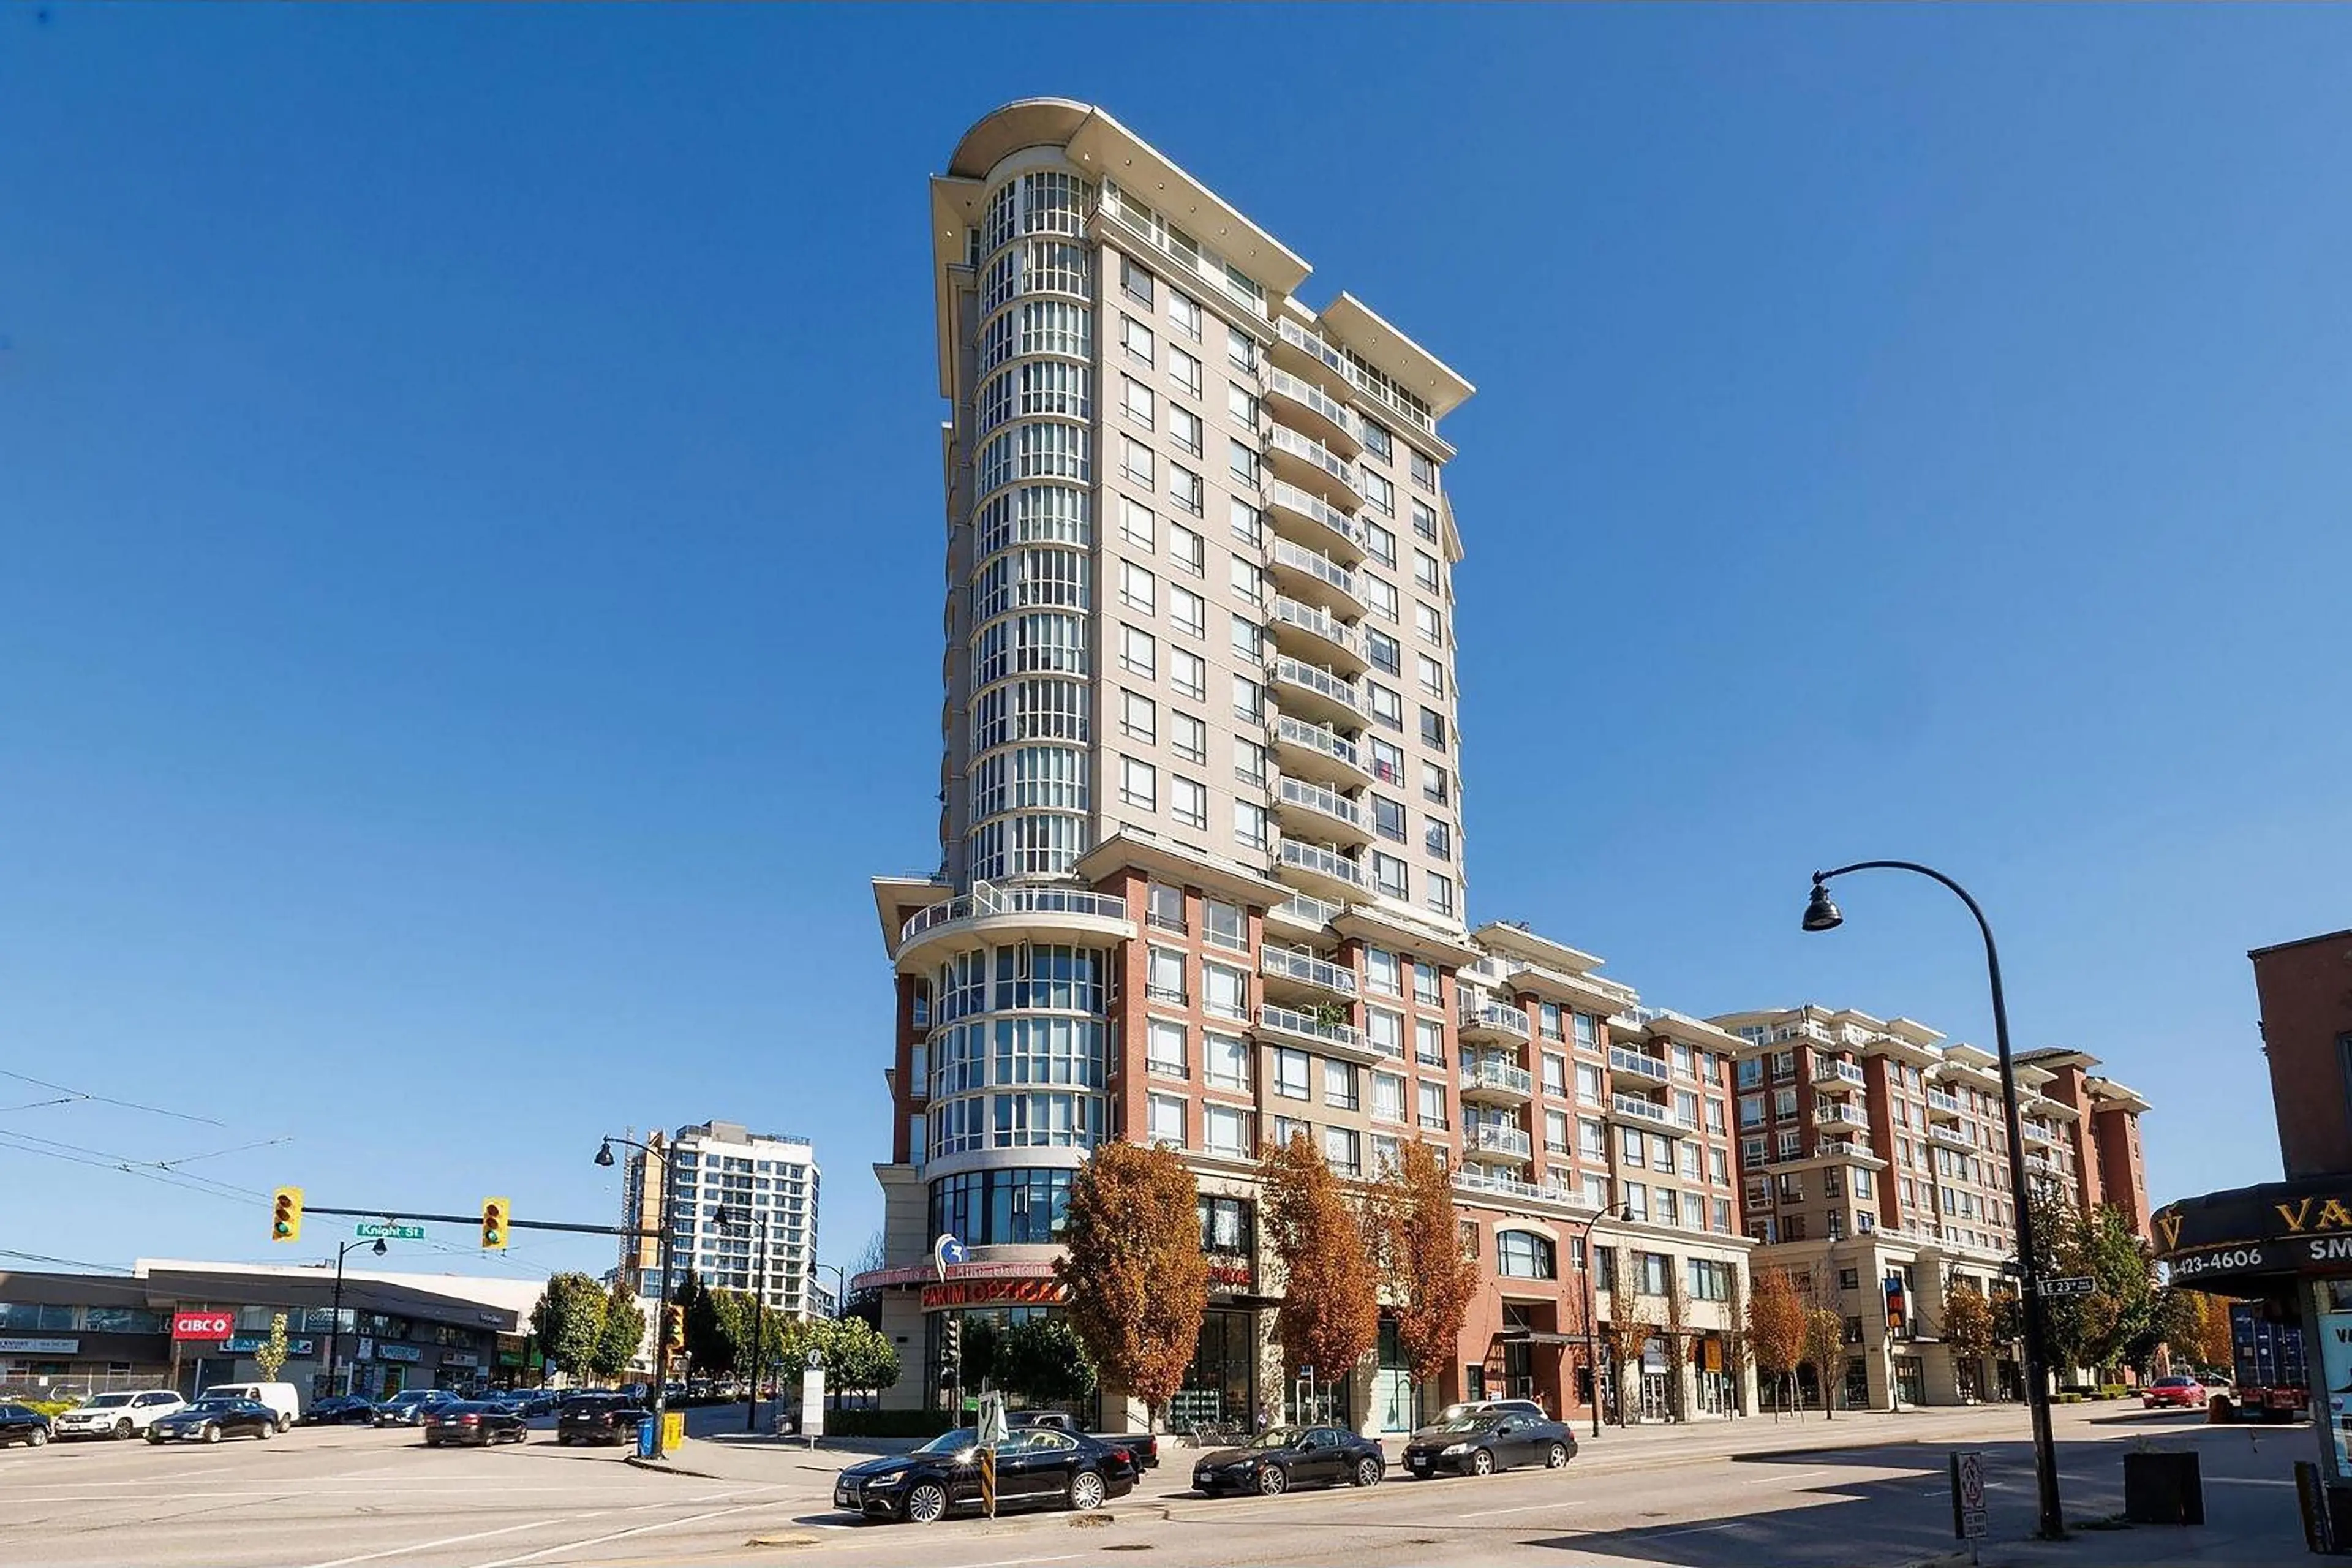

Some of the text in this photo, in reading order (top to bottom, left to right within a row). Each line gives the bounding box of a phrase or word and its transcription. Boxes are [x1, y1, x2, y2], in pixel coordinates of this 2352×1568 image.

[361, 1225, 419, 1237] Knight St
[2046, 1283, 2054, 1292] E
[178, 1319, 213, 1332] CIBC
